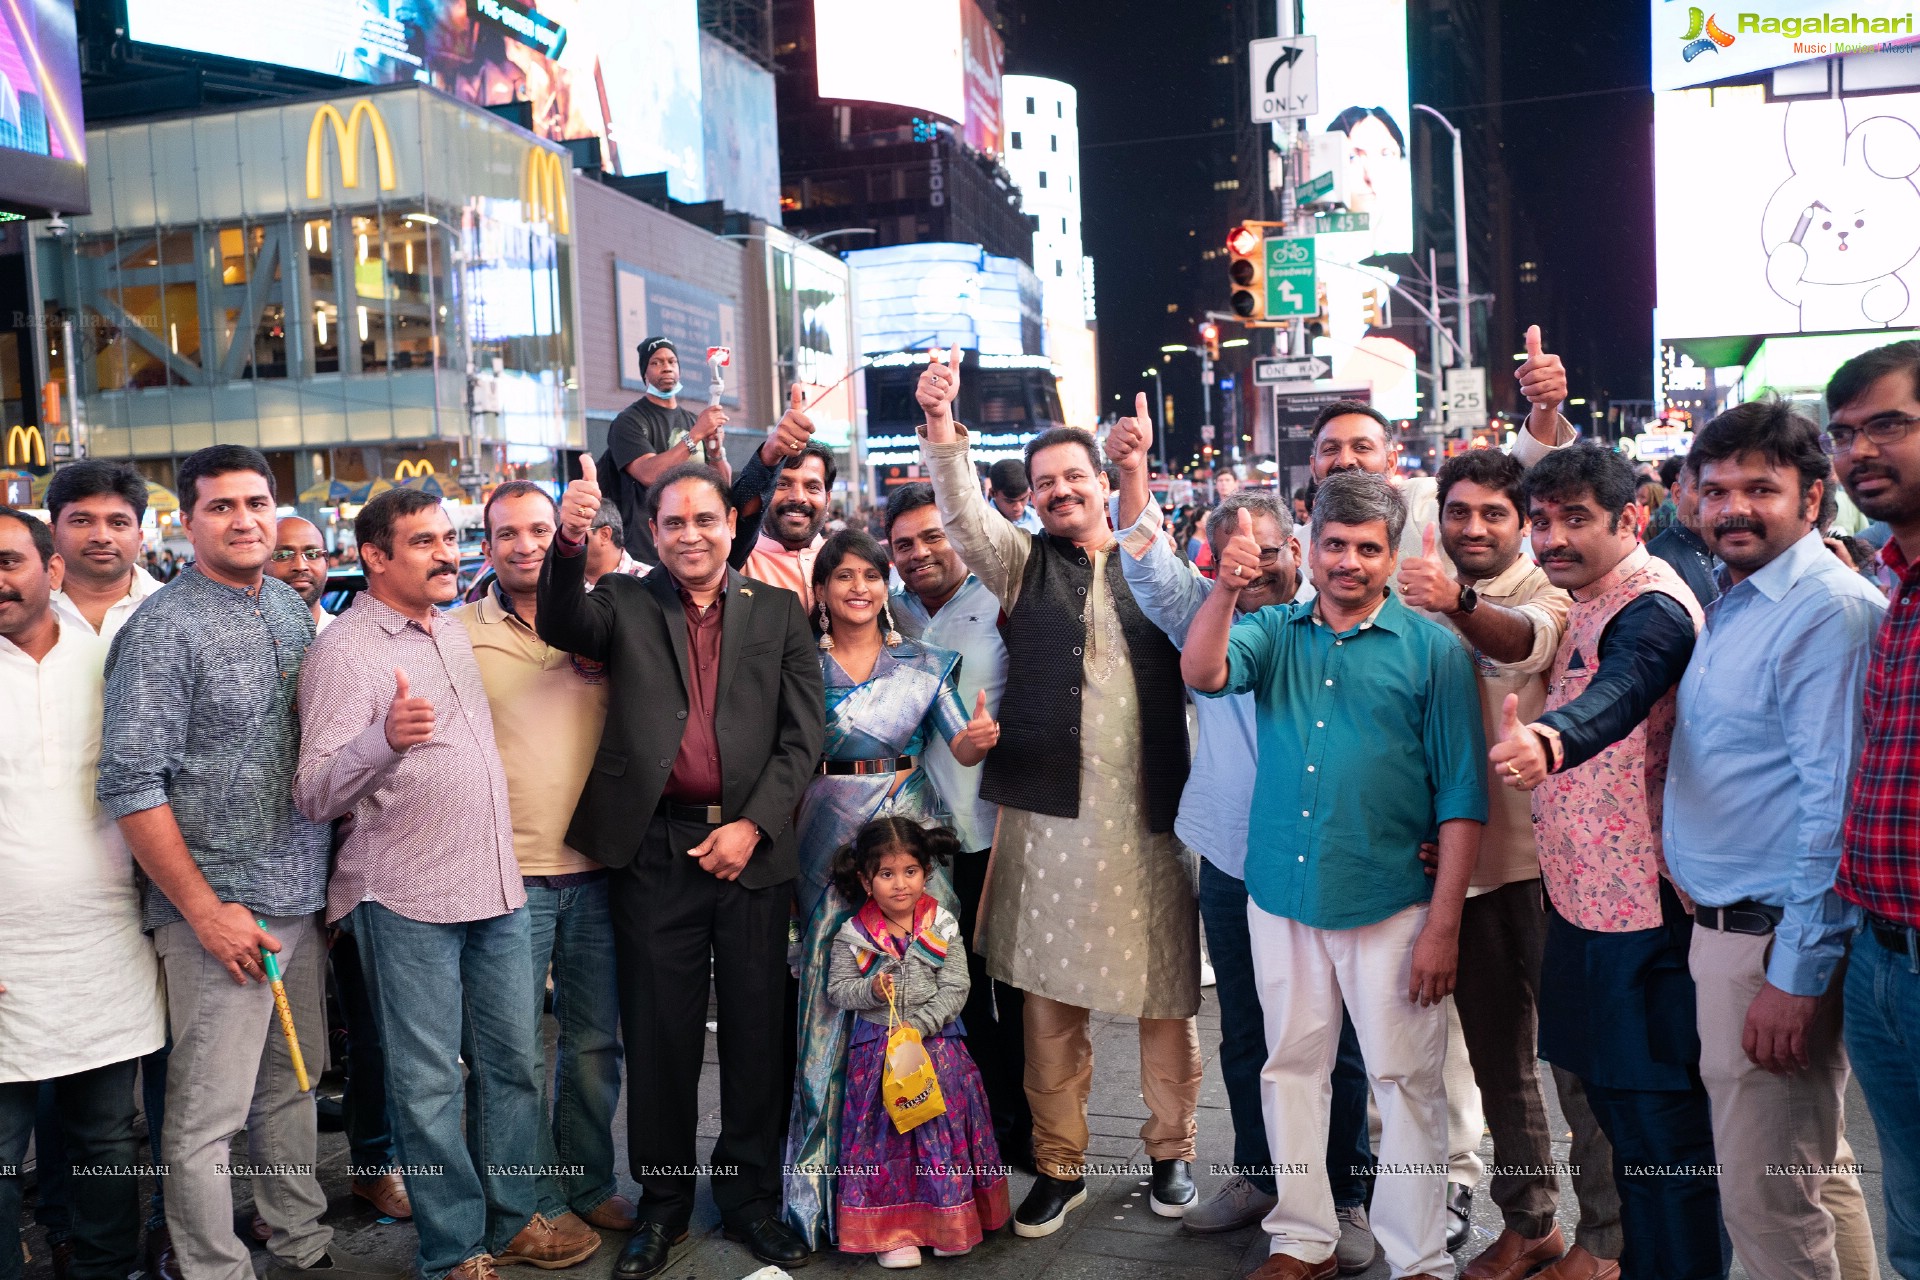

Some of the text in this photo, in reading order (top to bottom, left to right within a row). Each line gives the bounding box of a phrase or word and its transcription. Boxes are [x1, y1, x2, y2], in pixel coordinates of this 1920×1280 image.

[1263, 94, 1308, 113] ONLY
[929, 144, 945, 207] 1500
[1318, 216, 1332, 233] W
[1337, 215, 1354, 232] 45
[1269, 266, 1313, 278] Broadway
[1266, 362, 1321, 376] ONE WAY
[1454, 393, 1480, 408] 25
